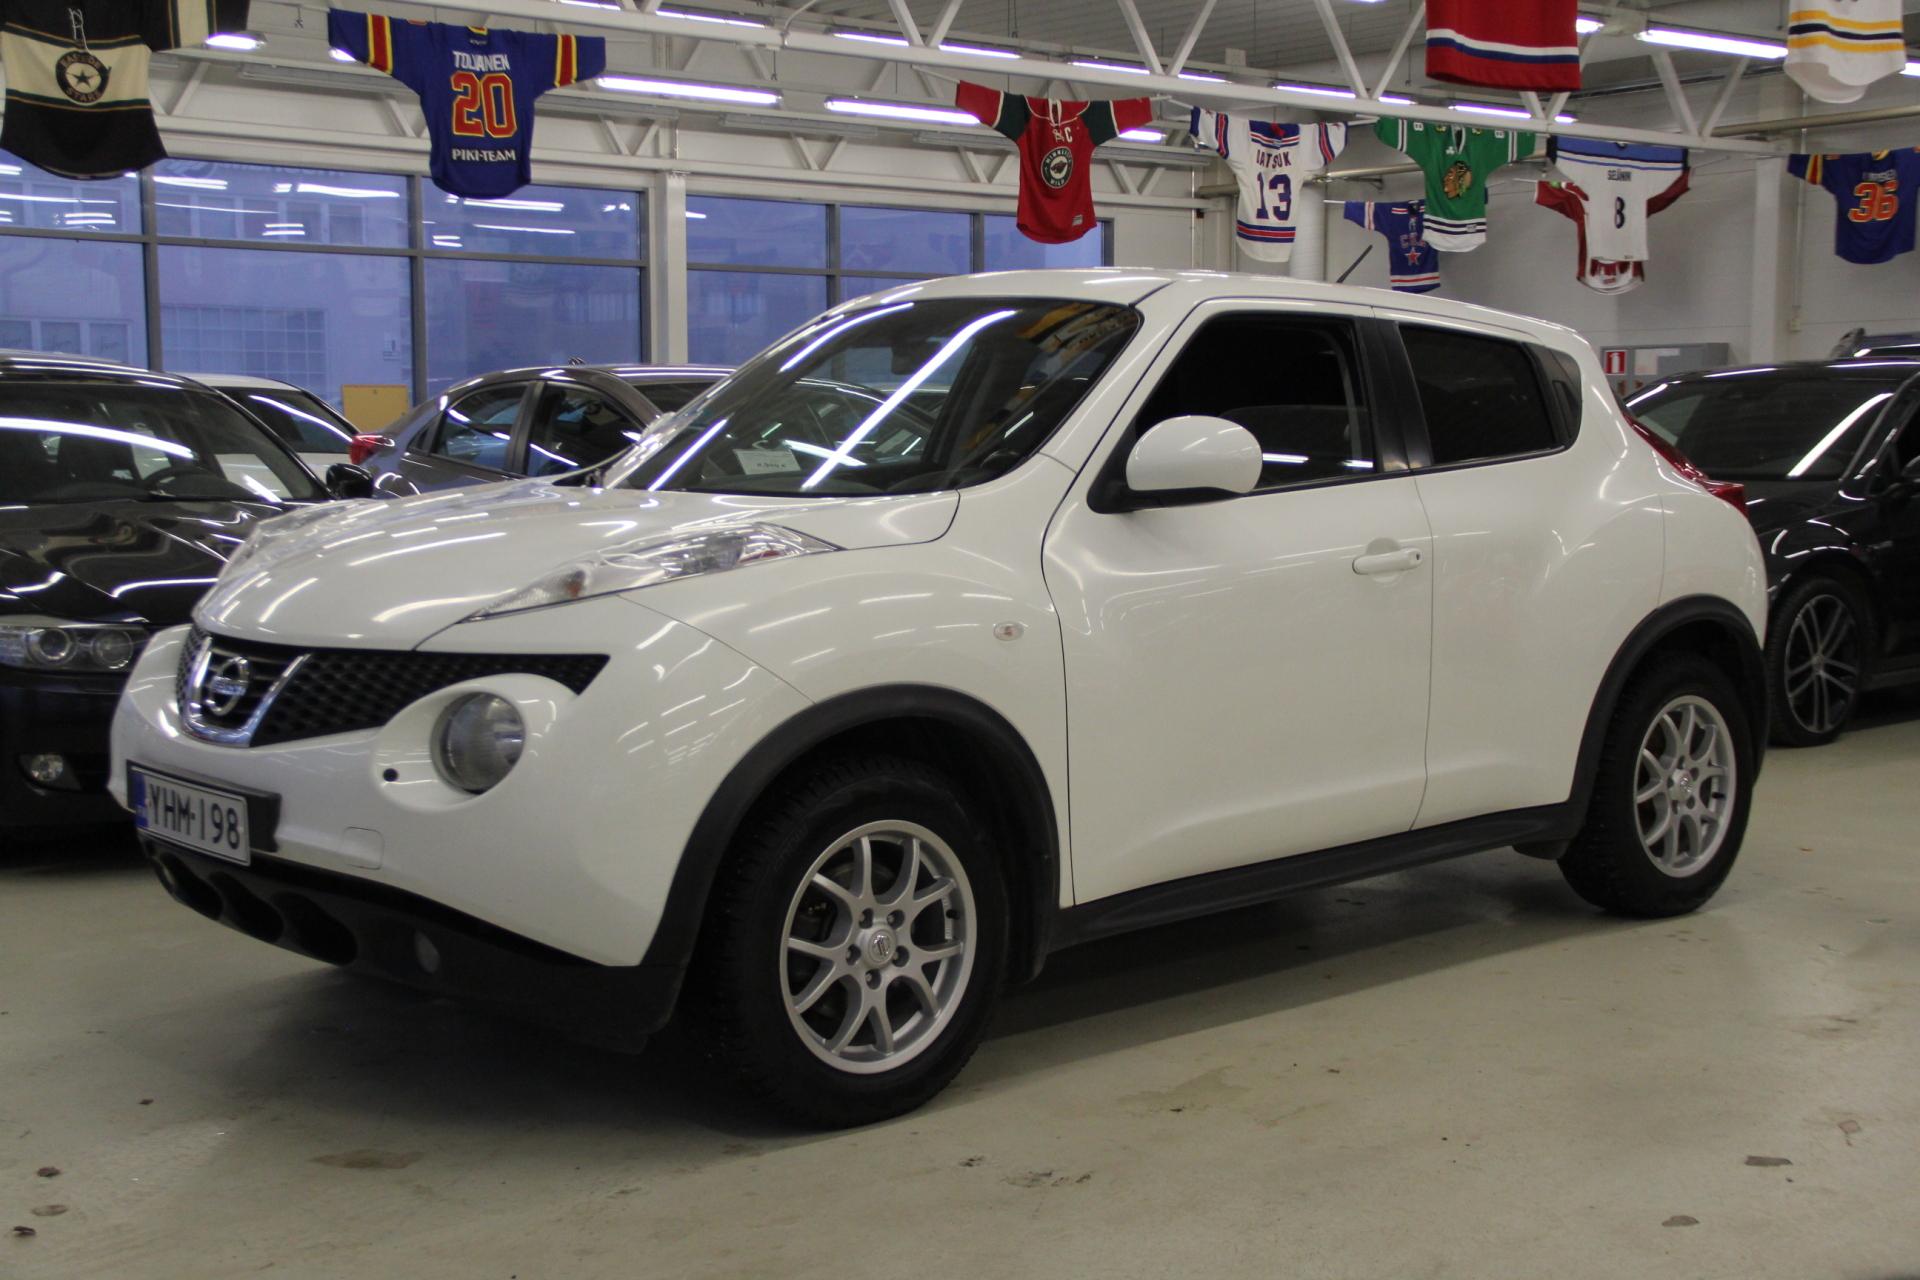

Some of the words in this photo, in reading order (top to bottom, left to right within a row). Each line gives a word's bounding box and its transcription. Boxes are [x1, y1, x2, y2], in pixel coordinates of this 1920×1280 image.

[451, 71, 518, 138] 20
[452, 148, 516, 162] PIKI-TEAM
[1064, 126, 1073, 143] C
[1256, 172, 1292, 221] 13
[1615, 196, 1625, 229] 8
[1848, 180, 1898, 222] 36
[150, 783, 241, 850] YHM-198
